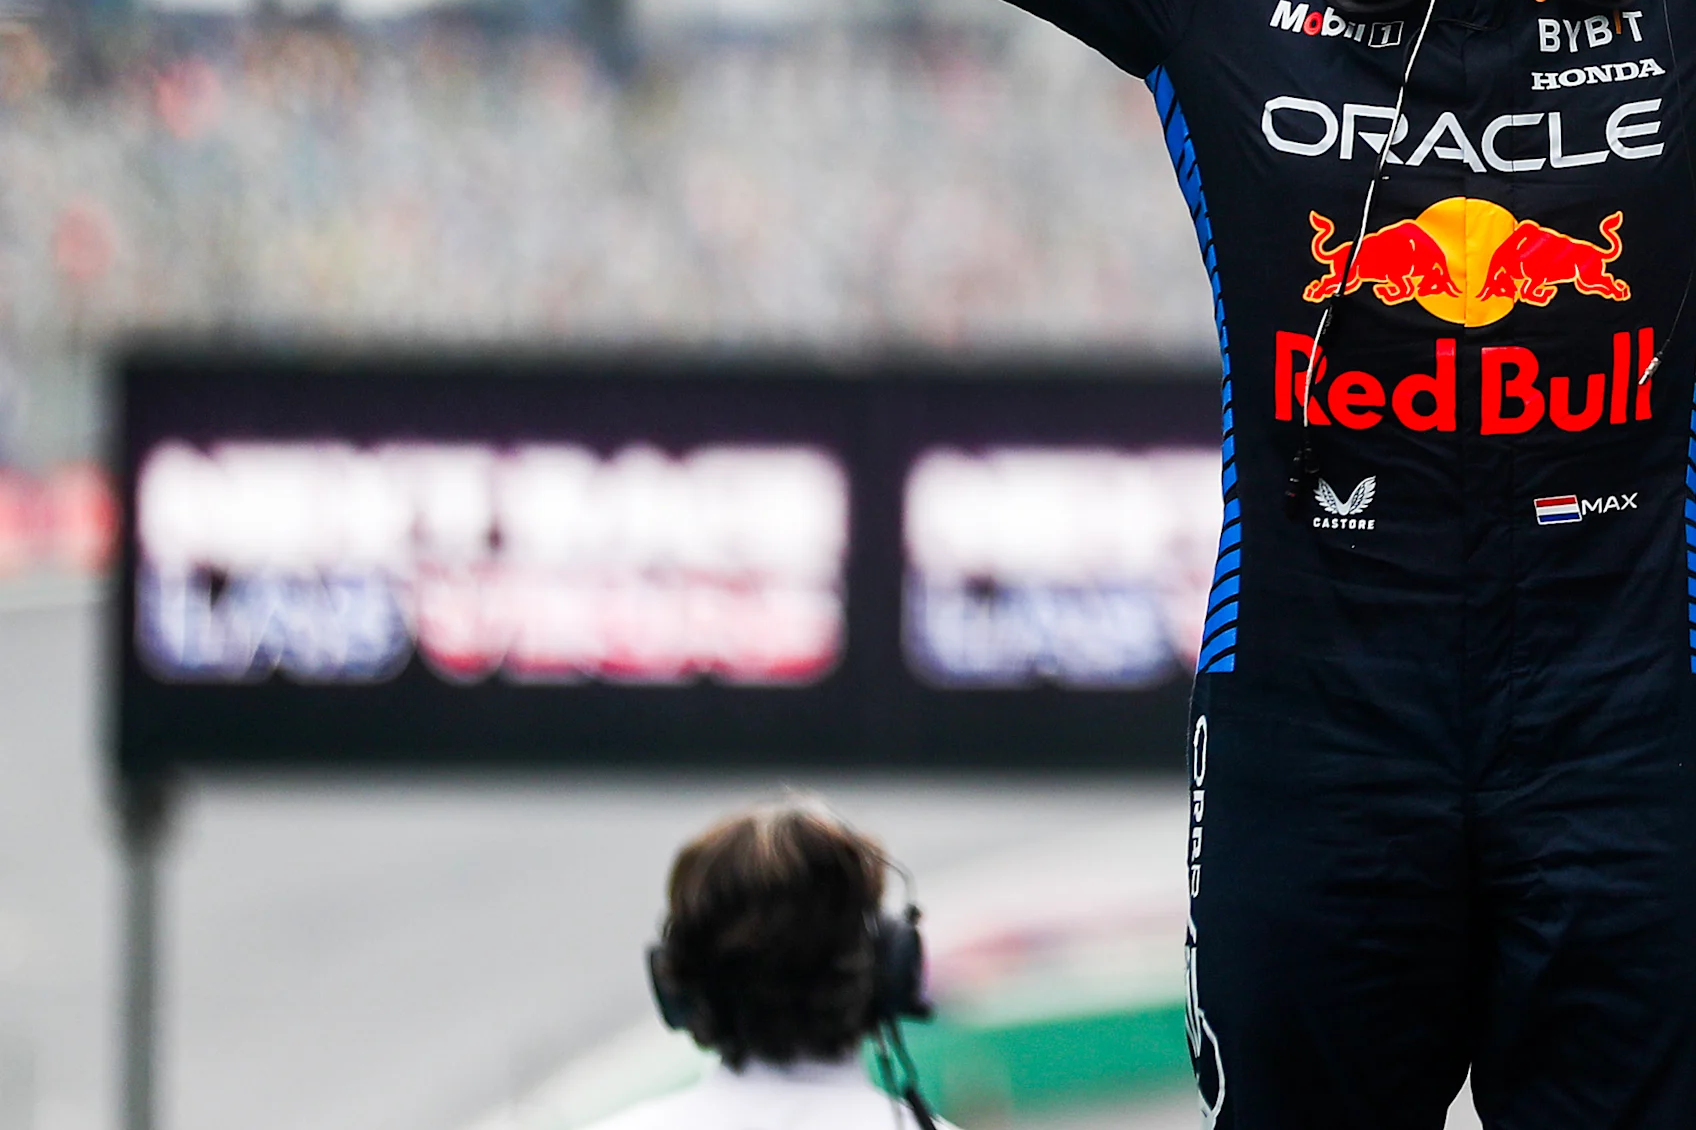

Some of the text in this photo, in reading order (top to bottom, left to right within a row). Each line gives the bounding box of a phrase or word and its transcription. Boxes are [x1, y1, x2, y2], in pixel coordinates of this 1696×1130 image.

[1269, 0, 1367, 43] Mobil
[1538, 10, 1644, 53] BYBIT
[1531, 58, 1666, 91] HONDA
[1261, 96, 1665, 173] ORACLE
[1275, 327, 1655, 436] Red Bull
[1312, 516, 1375, 531] CASTORE
[1580, 492, 1638, 517] MAX
